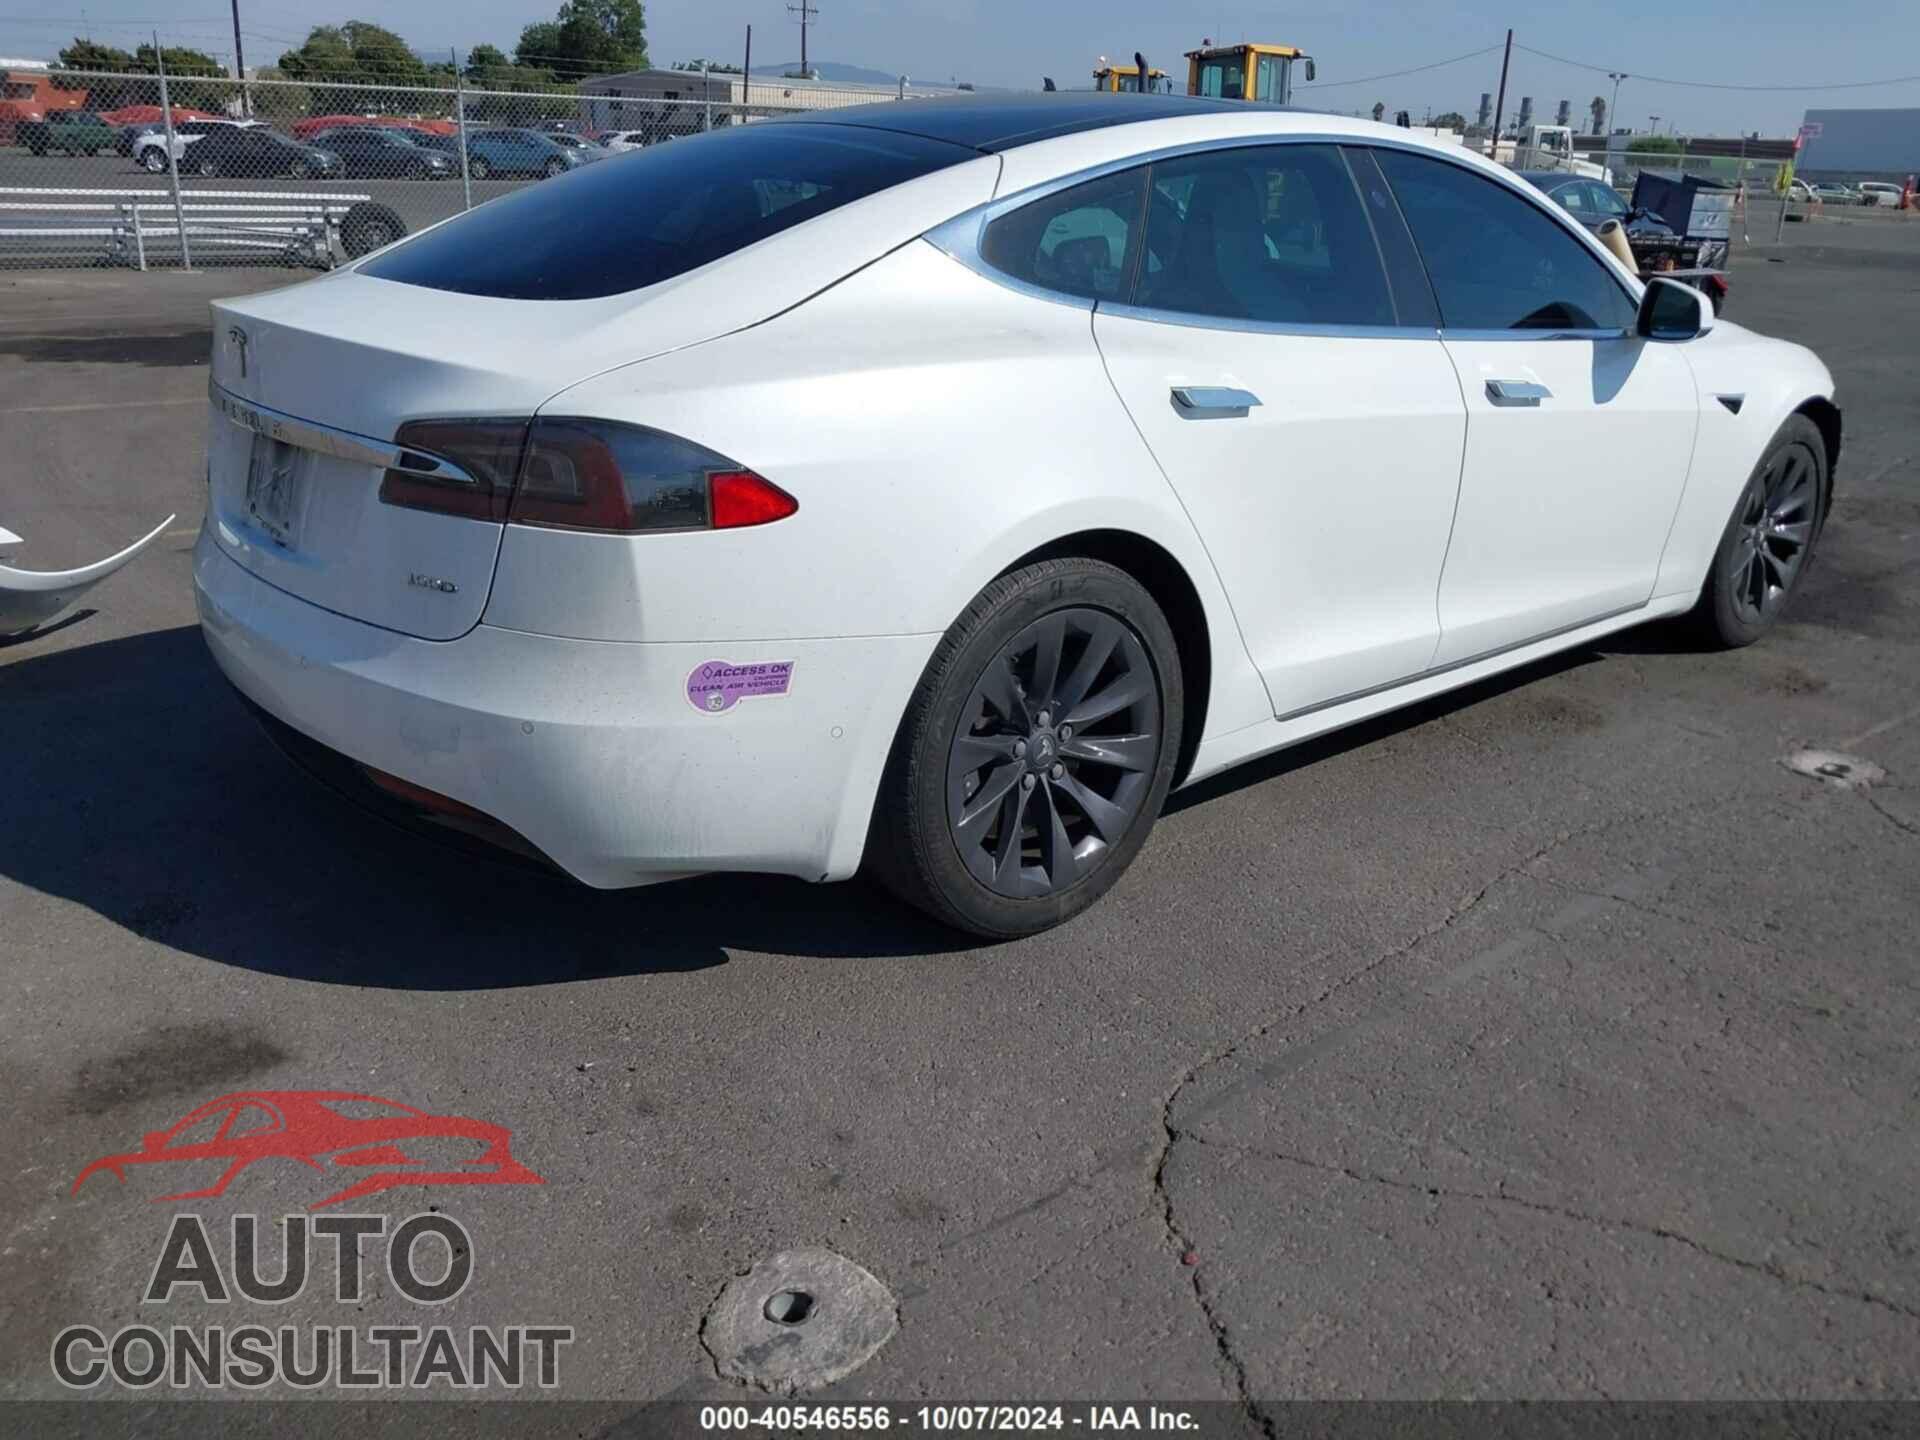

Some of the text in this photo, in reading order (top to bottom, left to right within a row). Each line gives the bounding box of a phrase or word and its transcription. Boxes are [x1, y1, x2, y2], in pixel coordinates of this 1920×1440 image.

[713, 666, 767, 678] ACCESS
[771, 664, 790, 674] OK
[690, 679, 786, 693] CLEAN AIR VEHICLE
